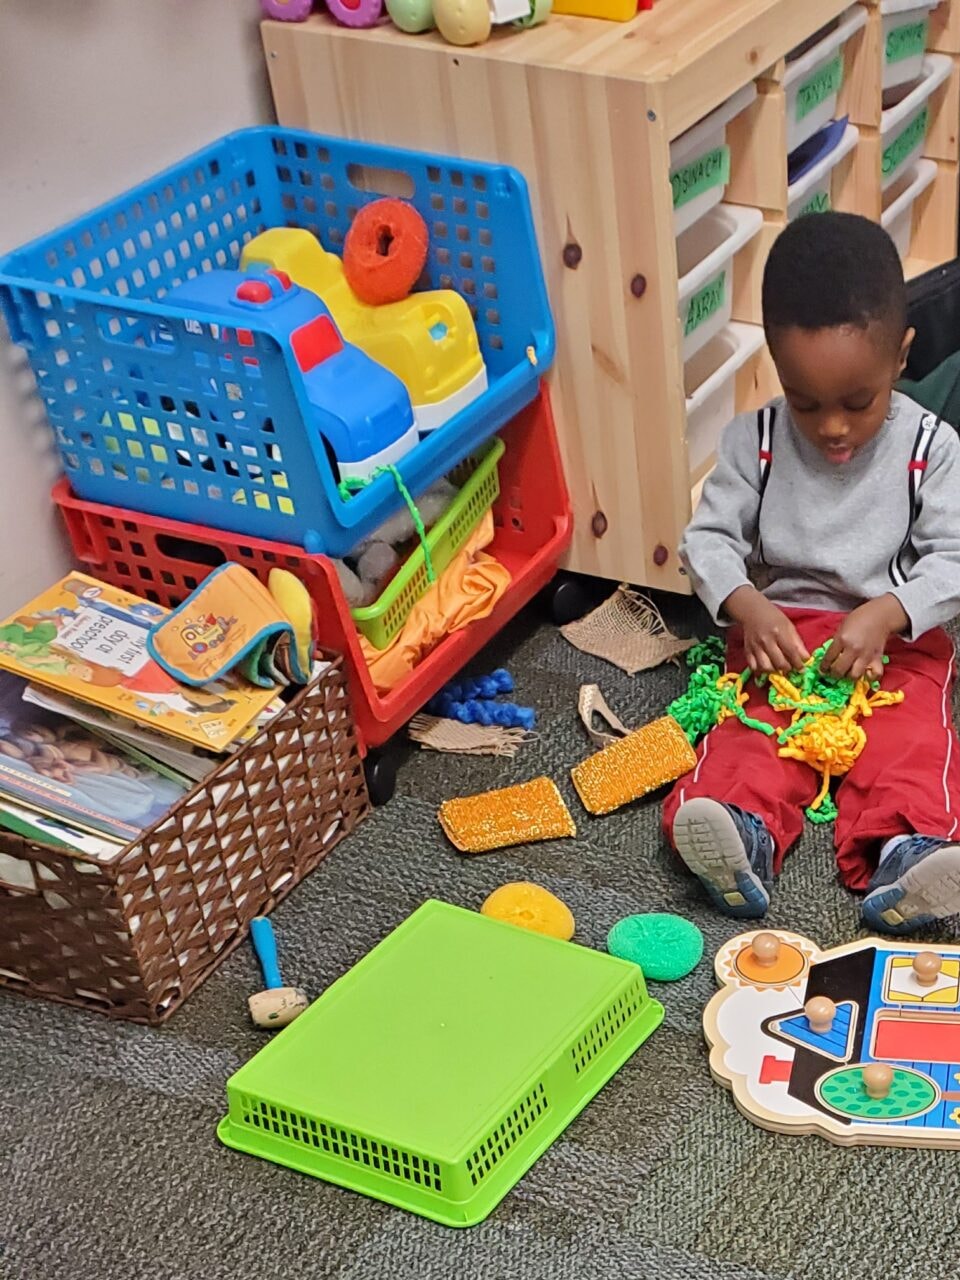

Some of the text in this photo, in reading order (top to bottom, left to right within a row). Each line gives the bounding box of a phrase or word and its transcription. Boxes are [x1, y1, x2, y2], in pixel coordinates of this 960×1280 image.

[70, 615, 113, 653] preschool
[95, 629, 130, 654] day at
[116, 648, 142, 664] first
